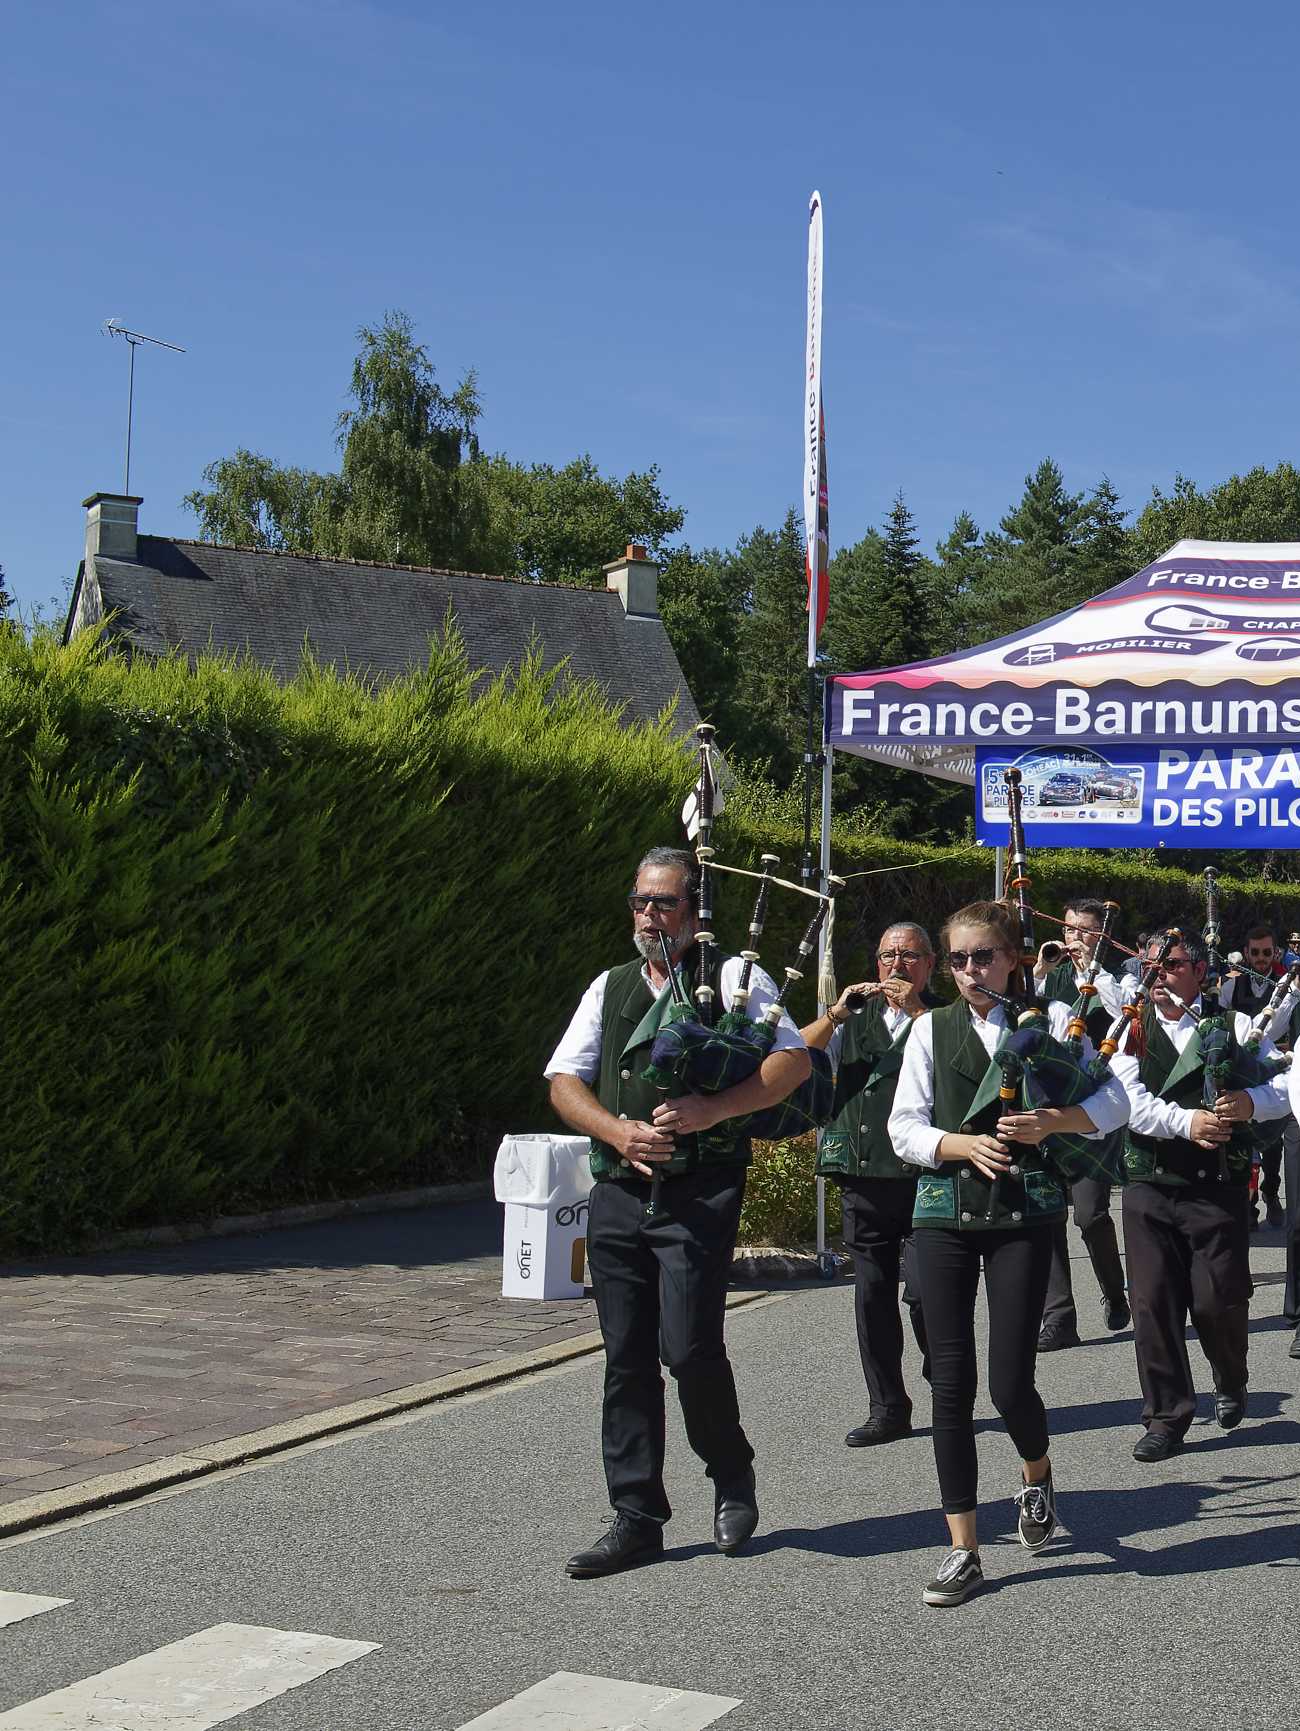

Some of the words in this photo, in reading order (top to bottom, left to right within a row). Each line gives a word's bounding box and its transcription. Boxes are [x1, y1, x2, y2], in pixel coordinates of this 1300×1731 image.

[1076, 639, 1192, 654] MOBILIER
[1022, 761, 1056, 777] LOHEAC
[987, 785, 1035, 796] PARDE
[994, 796, 1035, 806] PILES
[1153, 798, 1224, 827] DES
